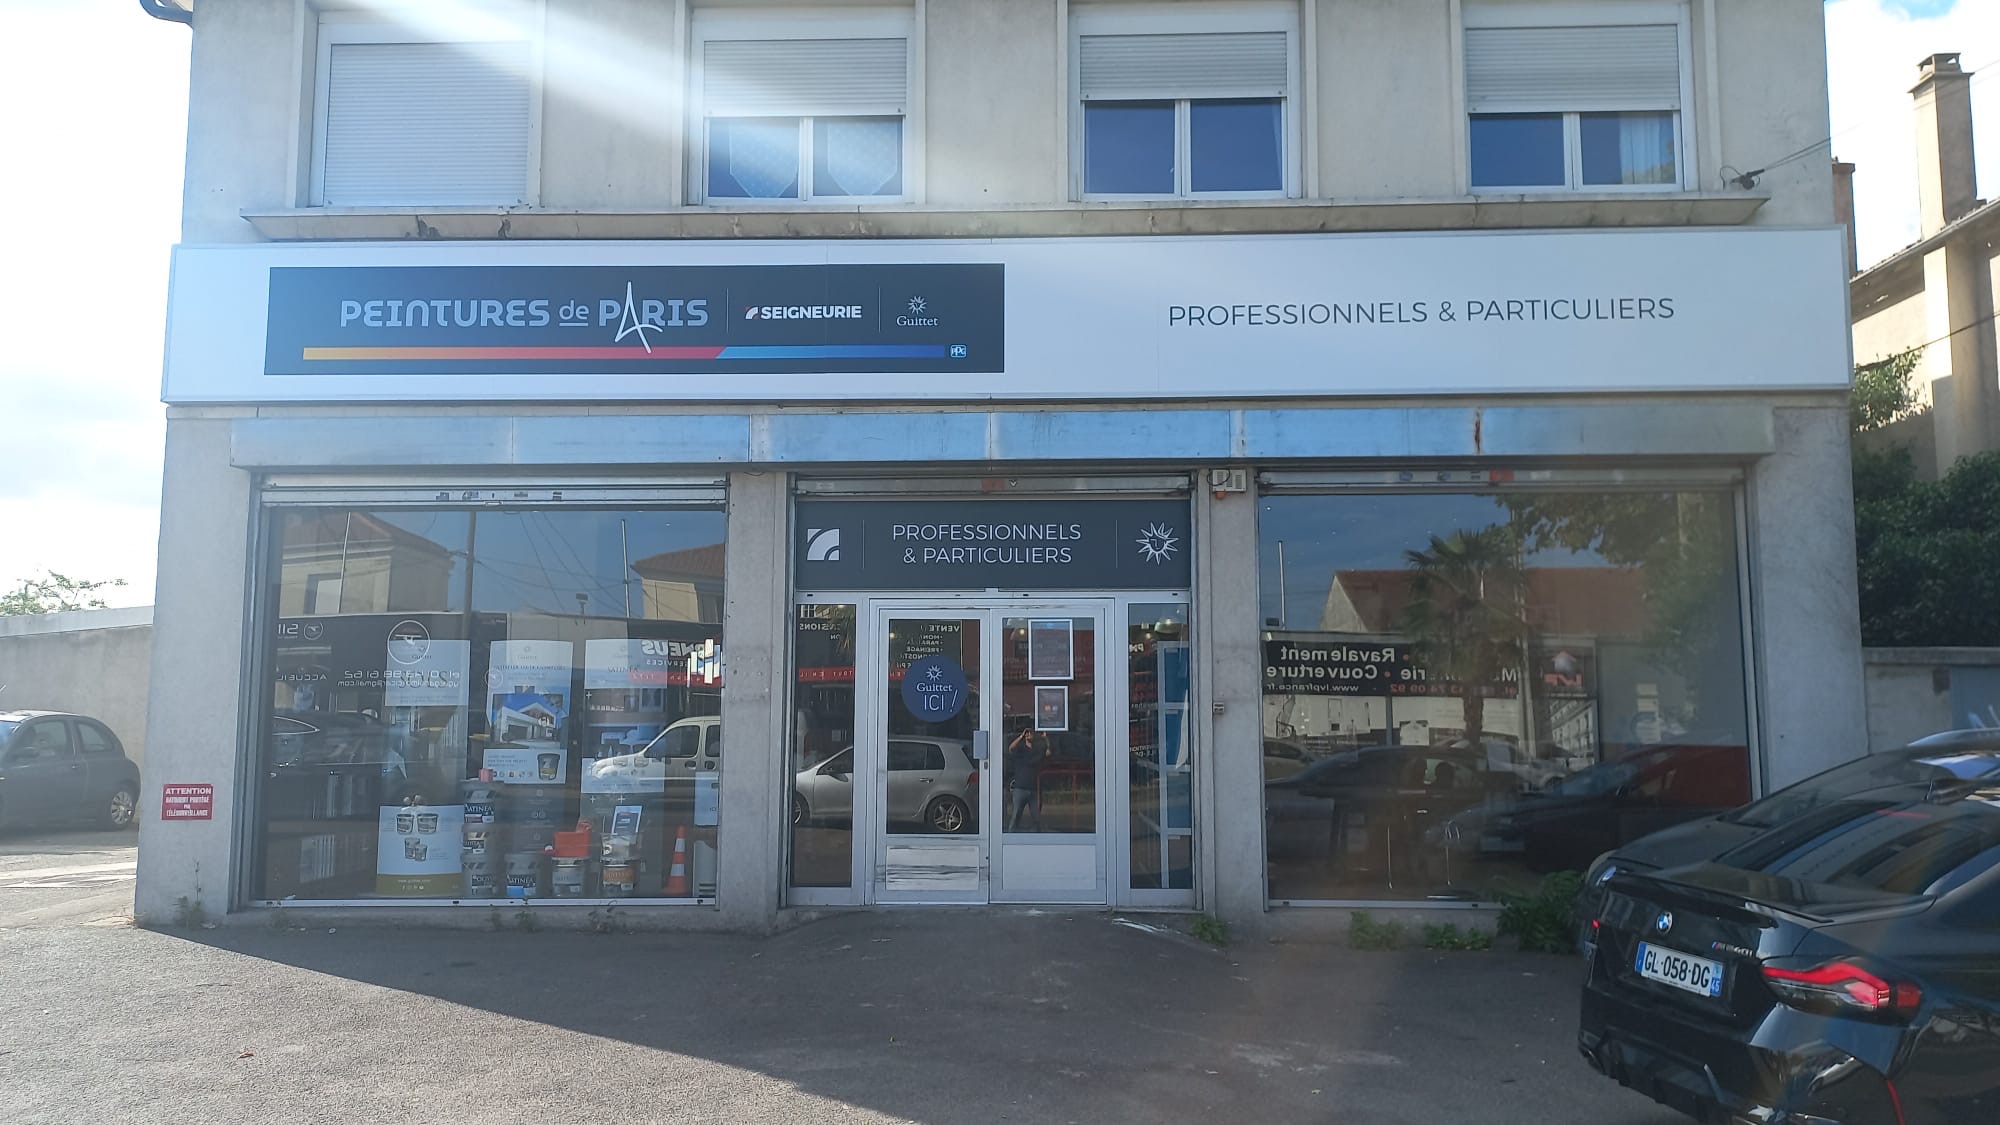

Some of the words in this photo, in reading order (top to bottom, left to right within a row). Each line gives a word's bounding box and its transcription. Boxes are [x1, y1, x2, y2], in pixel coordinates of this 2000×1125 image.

[341, 299, 550, 328] PEINTURES
[559, 300, 590, 326] de
[599, 281, 710, 353] PARIS
[760, 305, 862, 320] SEIGNEURIE
[1168, 301, 1428, 327] PROFESSIONNELS
[1438, 301, 1457, 322] &
[1466, 297, 1675, 321] PARTICULIERS
[896, 316, 938, 327] Guittet
[893, 523, 1081, 541] PROFESSIONNELS
[903, 547, 917, 564] &
[923, 547, 1072, 563] PARTICULIERS
[916, 682, 953, 692] Guittet
[924, 694, 944, 711] ICI
[165, 787, 212, 795] ATTENTION
